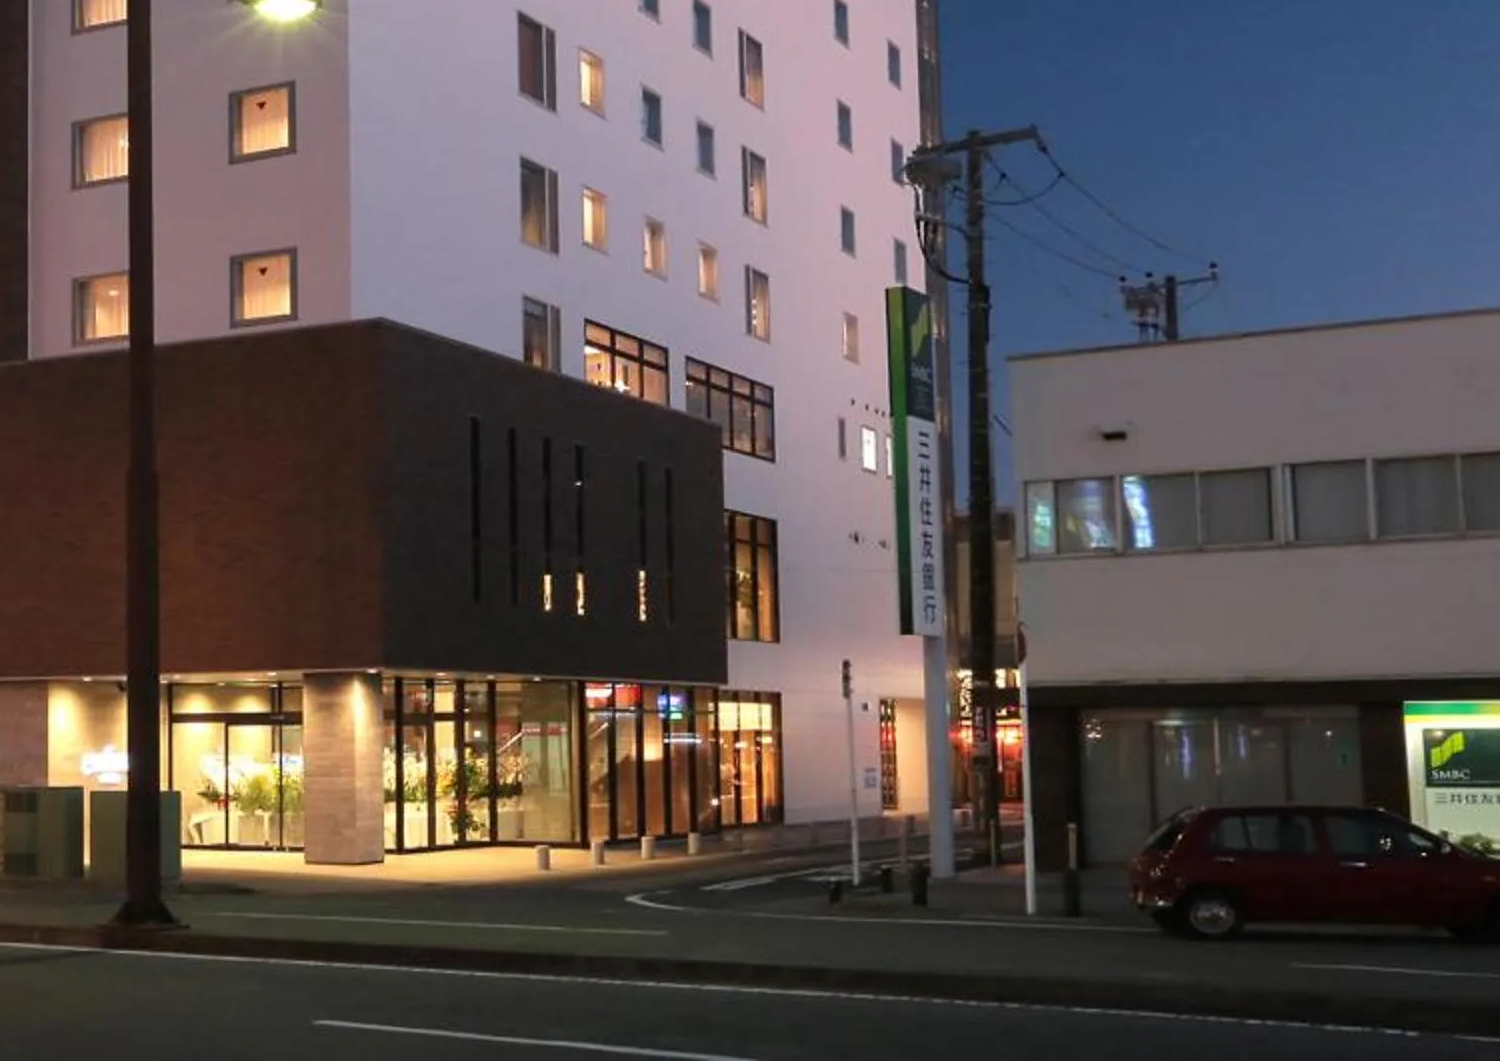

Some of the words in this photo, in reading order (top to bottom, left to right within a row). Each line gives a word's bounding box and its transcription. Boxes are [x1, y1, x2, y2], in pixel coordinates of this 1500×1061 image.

[916, 430, 937, 626] 三井住友銀行
[1431, 769, 1470, 780] SMBC
